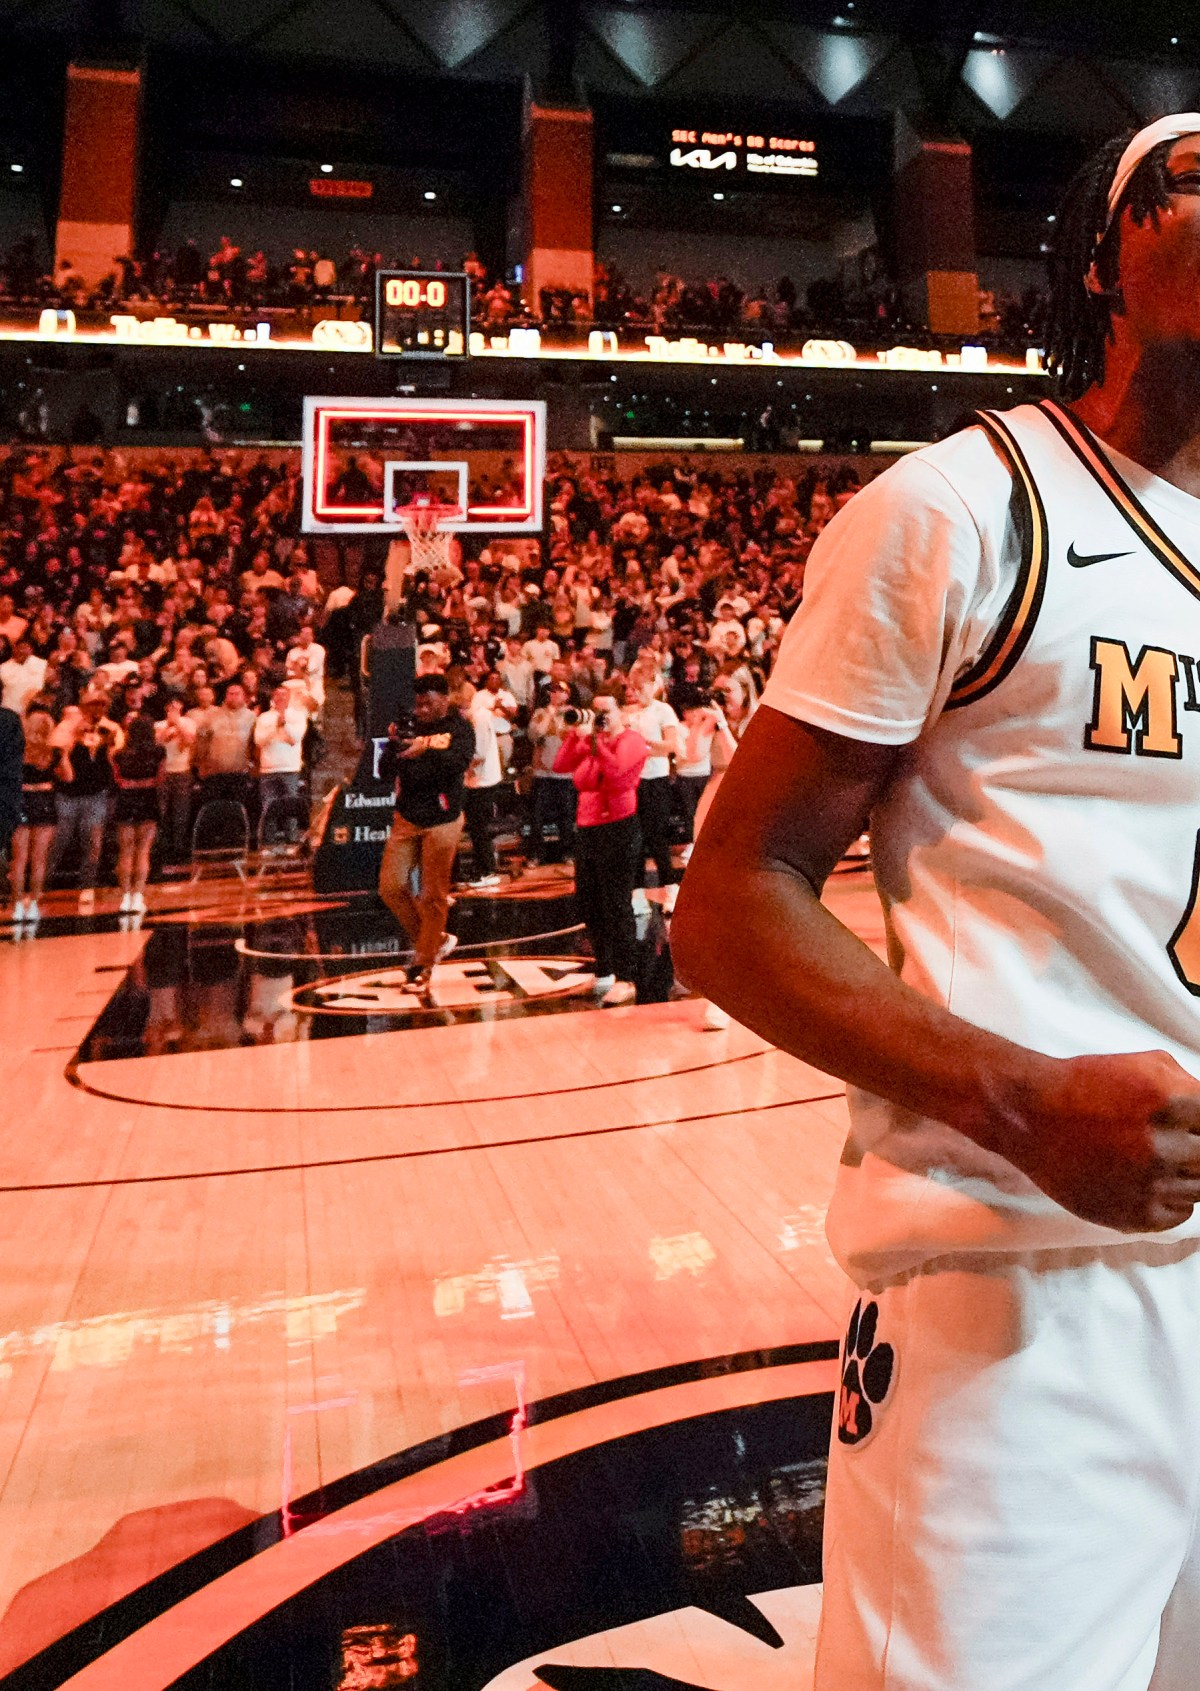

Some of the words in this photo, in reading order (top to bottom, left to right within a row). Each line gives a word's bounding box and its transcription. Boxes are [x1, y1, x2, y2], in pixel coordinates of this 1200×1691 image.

[386, 279, 445, 307] 00.0
[354, 824, 391, 842] Heal
[314, 957, 597, 1011] SEC
[839, 1385, 860, 1435] M
